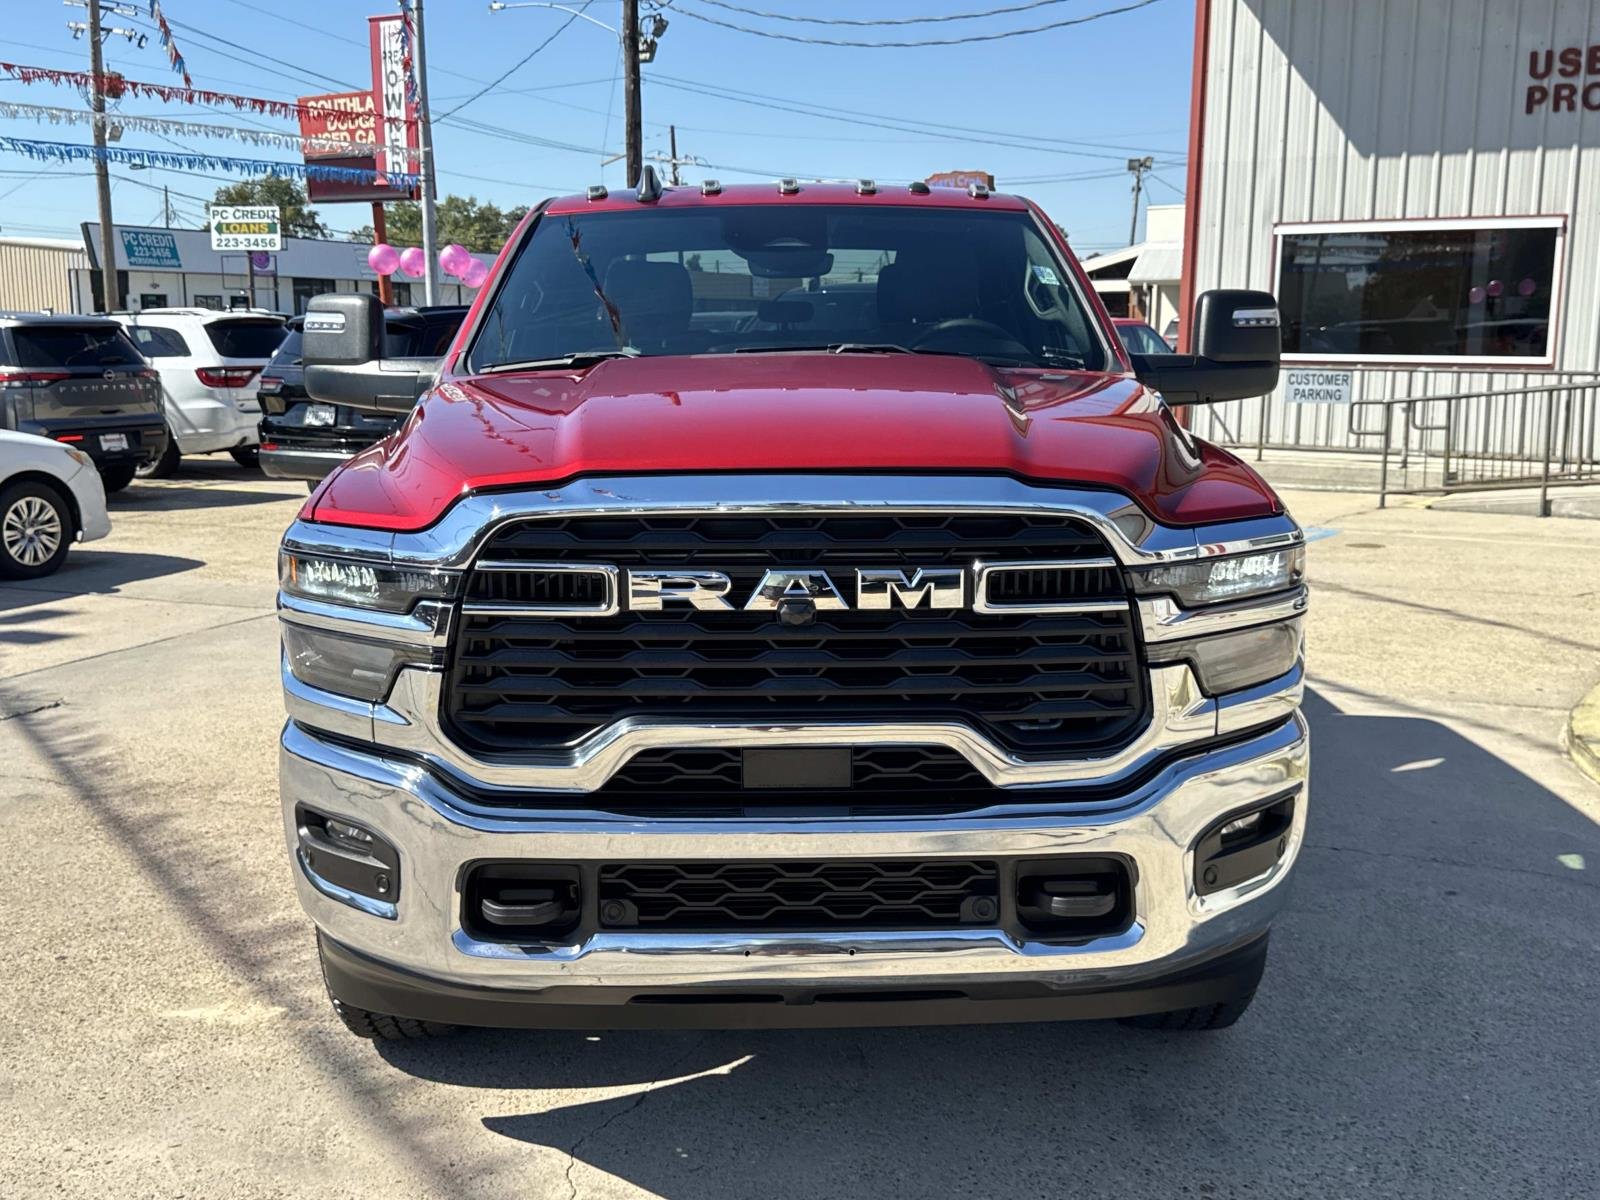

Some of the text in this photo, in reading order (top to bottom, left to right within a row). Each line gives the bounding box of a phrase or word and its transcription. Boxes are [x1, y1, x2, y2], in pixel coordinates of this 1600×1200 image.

[1529, 45, 1600, 79] USE
[212, 209, 277, 220] PC CREDIT
[222, 223, 269, 233] LOANS
[122, 232, 174, 248] PC CREDIT
[216, 238, 276, 248] 223-3456
[1288, 374, 1350, 386] CUSTOMER
[60, 383, 152, 393] PATHFINDER
[1294, 388, 1342, 400] PARKING
[627, 568, 966, 611] RAM
